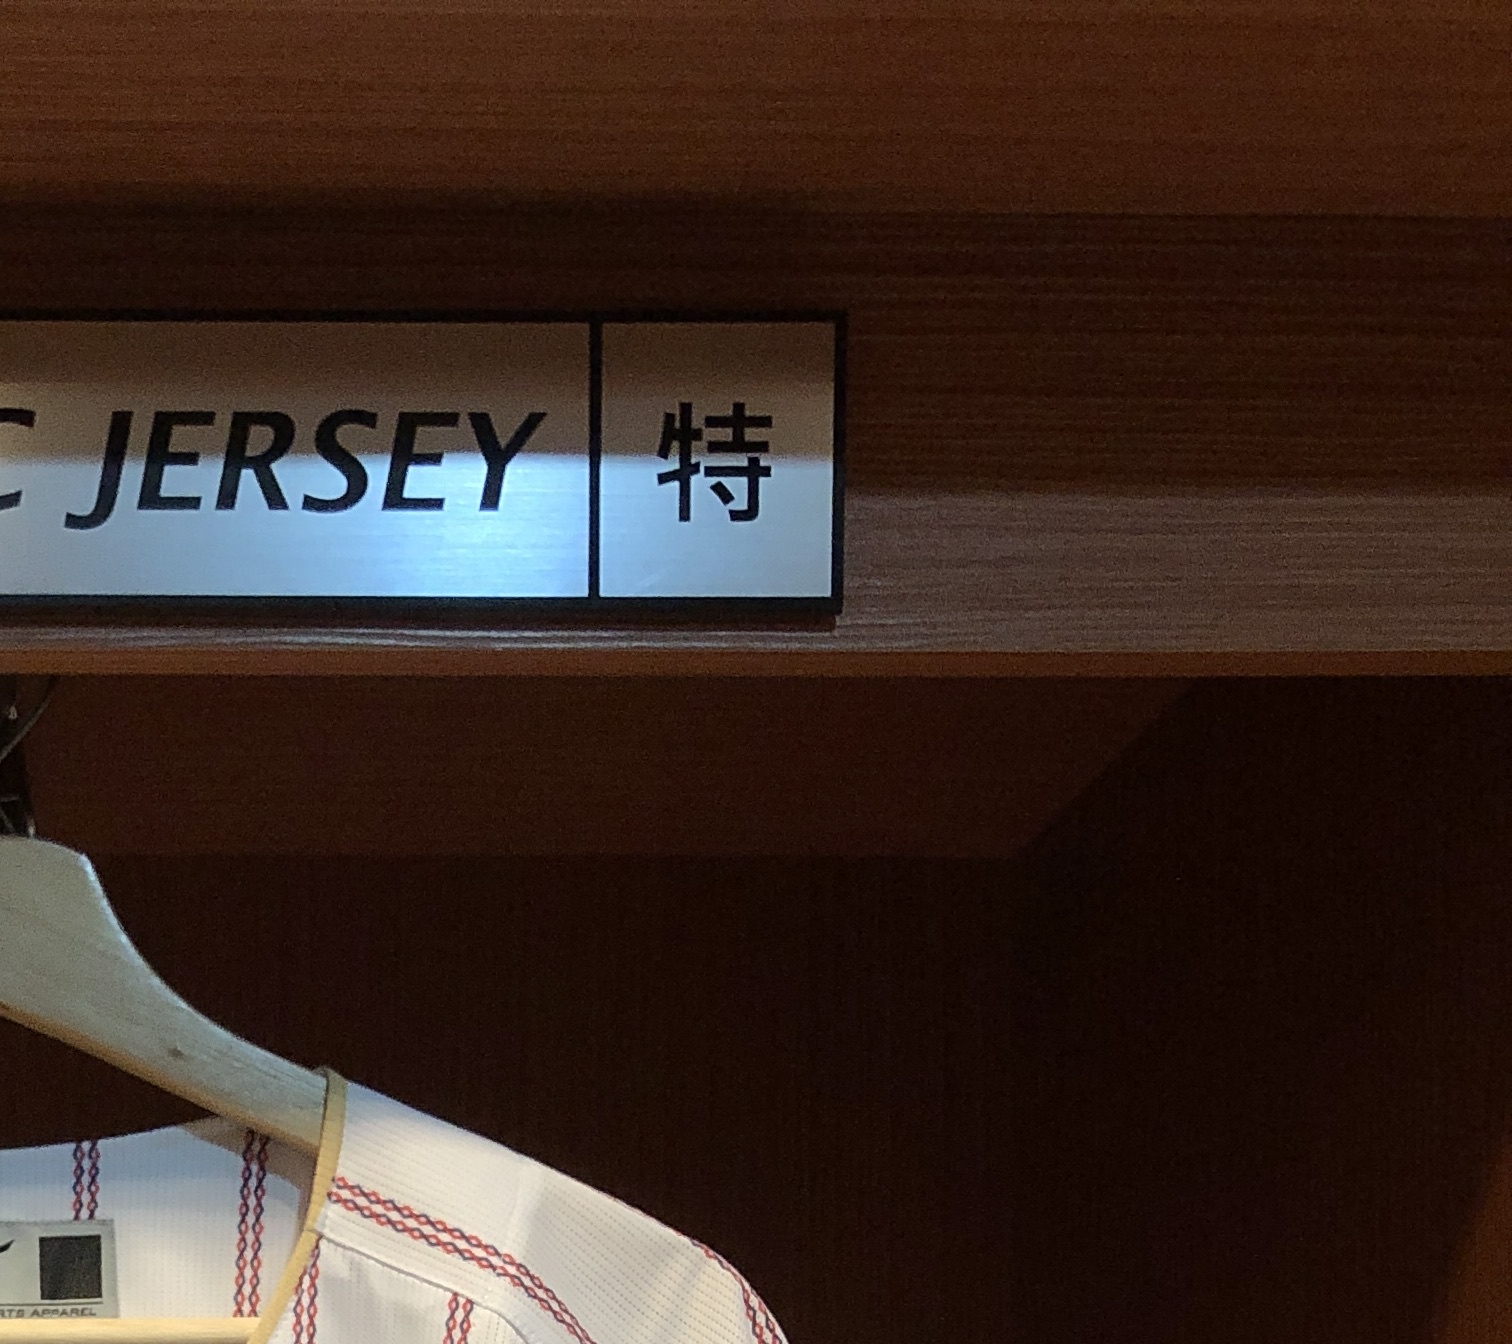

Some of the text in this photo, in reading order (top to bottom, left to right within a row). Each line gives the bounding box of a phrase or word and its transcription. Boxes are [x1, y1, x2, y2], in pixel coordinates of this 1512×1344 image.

[64, 409, 547, 532] JERSEY
[655, 401, 774, 522] 特
[30, 1307, 96, 1317] APPAREL
